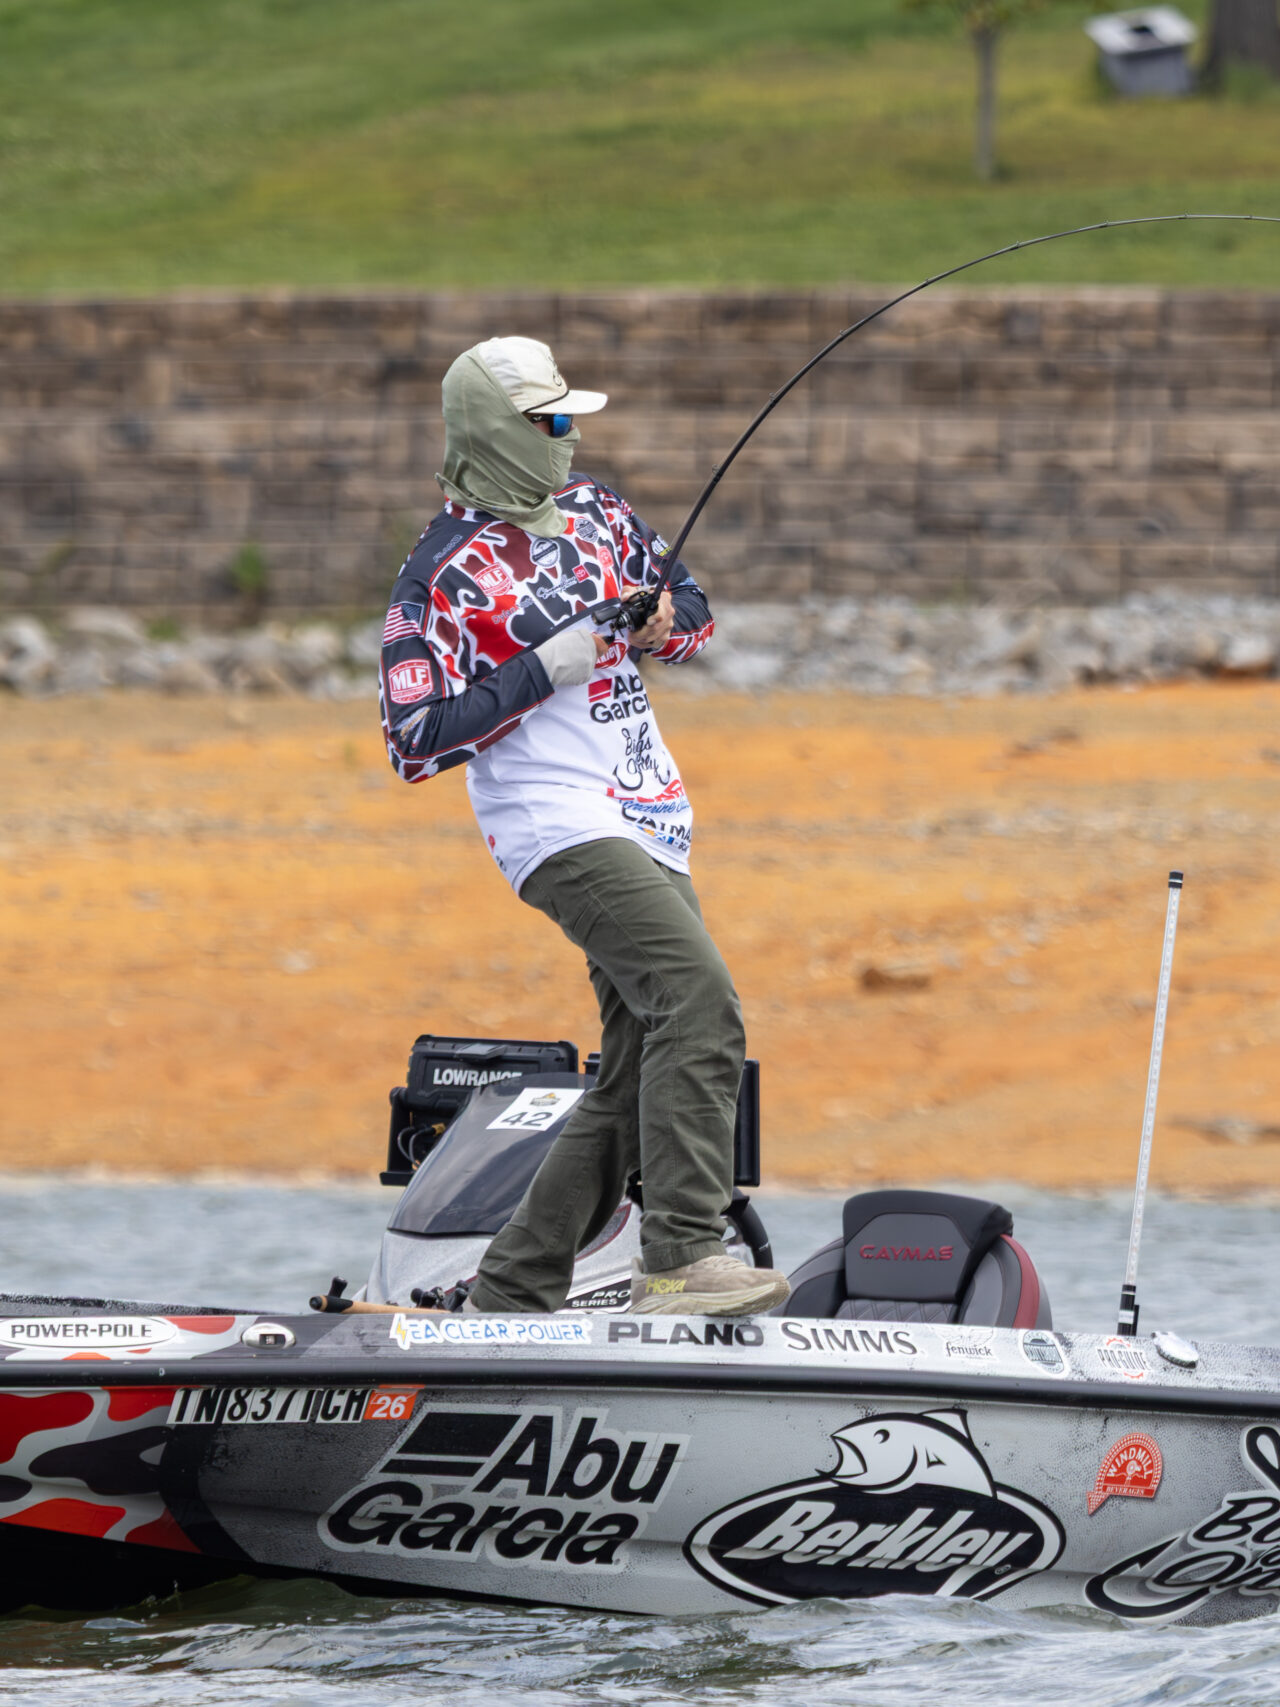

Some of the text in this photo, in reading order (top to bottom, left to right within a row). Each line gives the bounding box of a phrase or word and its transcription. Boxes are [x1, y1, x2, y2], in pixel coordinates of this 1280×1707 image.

[480, 568, 505, 591] MLF
[392, 667, 429, 691] MLF
[613, 674, 644, 700] Ab
[432, 1063, 522, 1087] LOWRAN
[500, 1111, 553, 1127] 42
[859, 1244, 955, 1261] CAYMAS
[592, 1289, 631, 1300] PRO
[645, 1277, 688, 1294] HOKA
[571, 1298, 618, 1308] SERIES
[11, 1322, 153, 1339] POWER-POLE
[445, 1323, 509, 1341] CLEAR
[517, 1323, 586, 1341] POWER
[607, 1320, 765, 1347] PLANO
[780, 1321, 918, 1356] SIMMS
[945, 1341, 993, 1357] fenwick
[371, 1395, 407, 1419] 26
[472, 1414, 682, 1504] Abu
[1106, 1447, 1153, 1480] WINDMILL
[327, 1480, 640, 1565] Garcia
[722, 1500, 1034, 1598] Berkley
